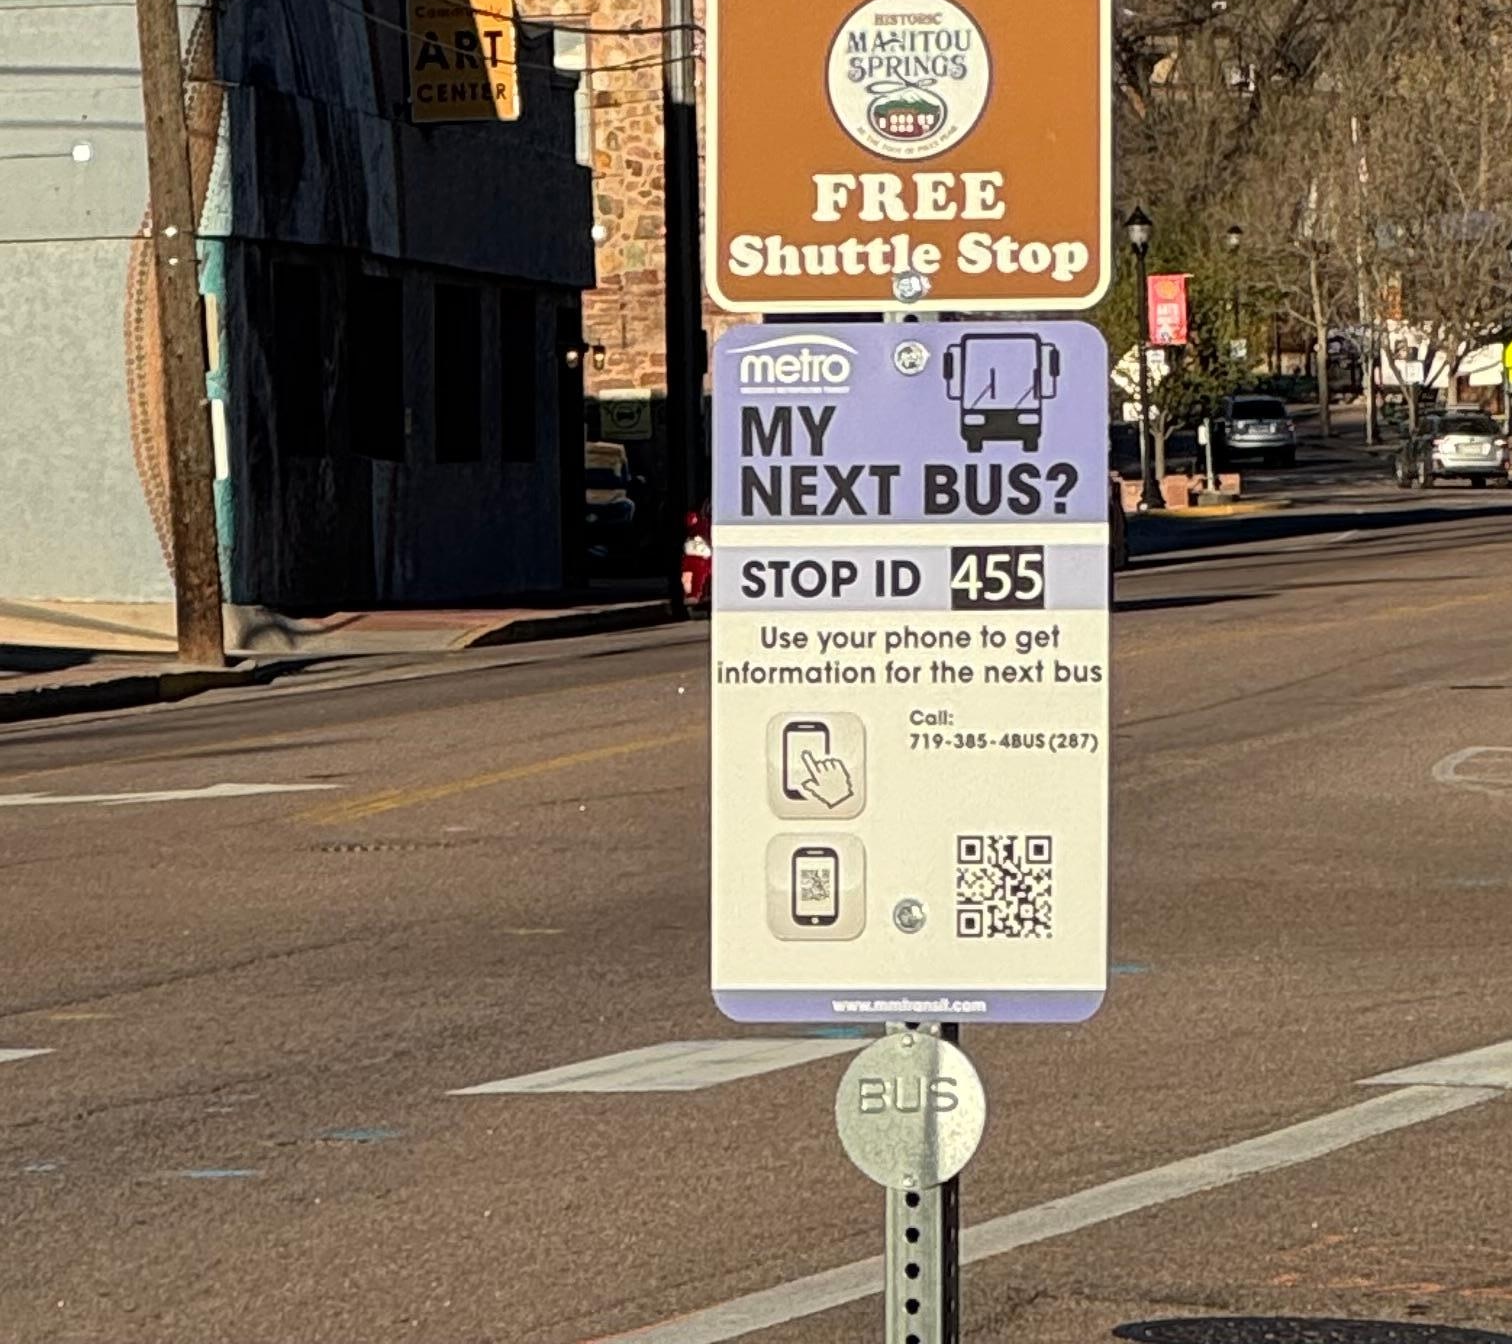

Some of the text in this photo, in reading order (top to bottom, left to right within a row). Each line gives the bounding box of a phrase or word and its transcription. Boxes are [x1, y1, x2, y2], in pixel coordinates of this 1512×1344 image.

[415, 30, 503, 71] ART
[847, 29, 972, 53] MANITOU
[848, 55, 968, 82] SPRINGS
[416, 82, 507, 102] CENTER
[811, 170, 1006, 222] FREE
[728, 232, 1090, 282] Shuttle Stop
[739, 348, 850, 383] metro
[741, 406, 837, 457] MY
[741, 463, 1079, 517] NEXT BUS?
[741, 553, 1043, 602] STOP ID 455
[760, 626, 1059, 653] Use your phone to get
[717, 661, 1102, 685] information for the next bus
[909, 709, 955, 726] Call:
[858, 1077, 959, 1114] BUS
